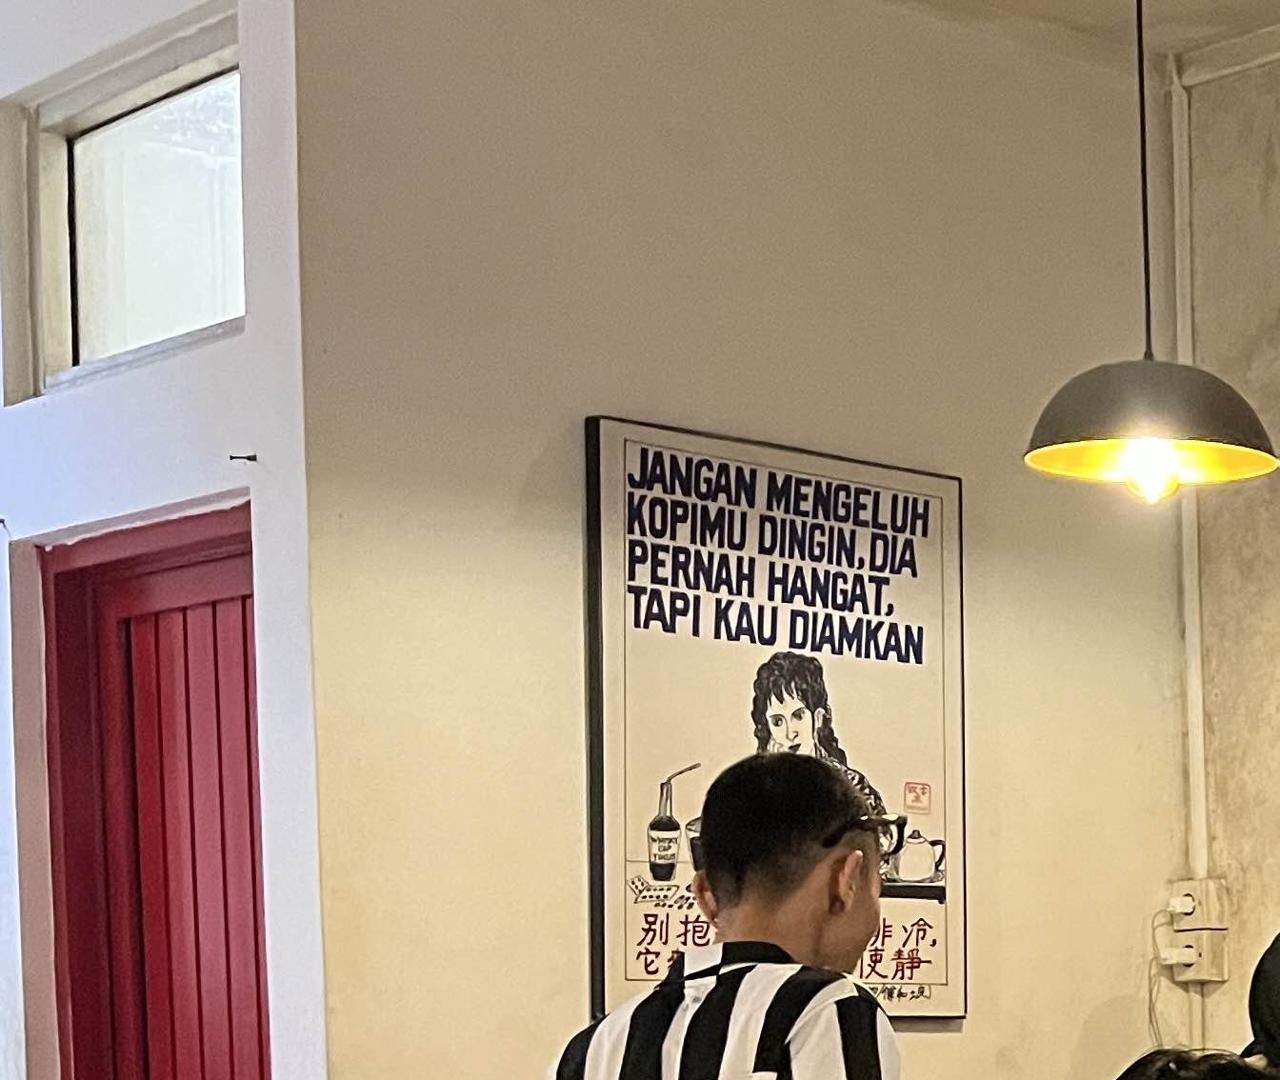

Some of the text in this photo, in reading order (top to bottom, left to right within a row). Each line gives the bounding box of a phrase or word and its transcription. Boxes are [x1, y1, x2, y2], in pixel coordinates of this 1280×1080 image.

[627, 447, 930, 537] JANGAN MENGELUH
[627, 491, 747, 551] KOPIMU
[627, 540, 894, 617] PERNAH HANGAT,
[627, 584, 924, 665] TAPI KAU DIAMKAN
